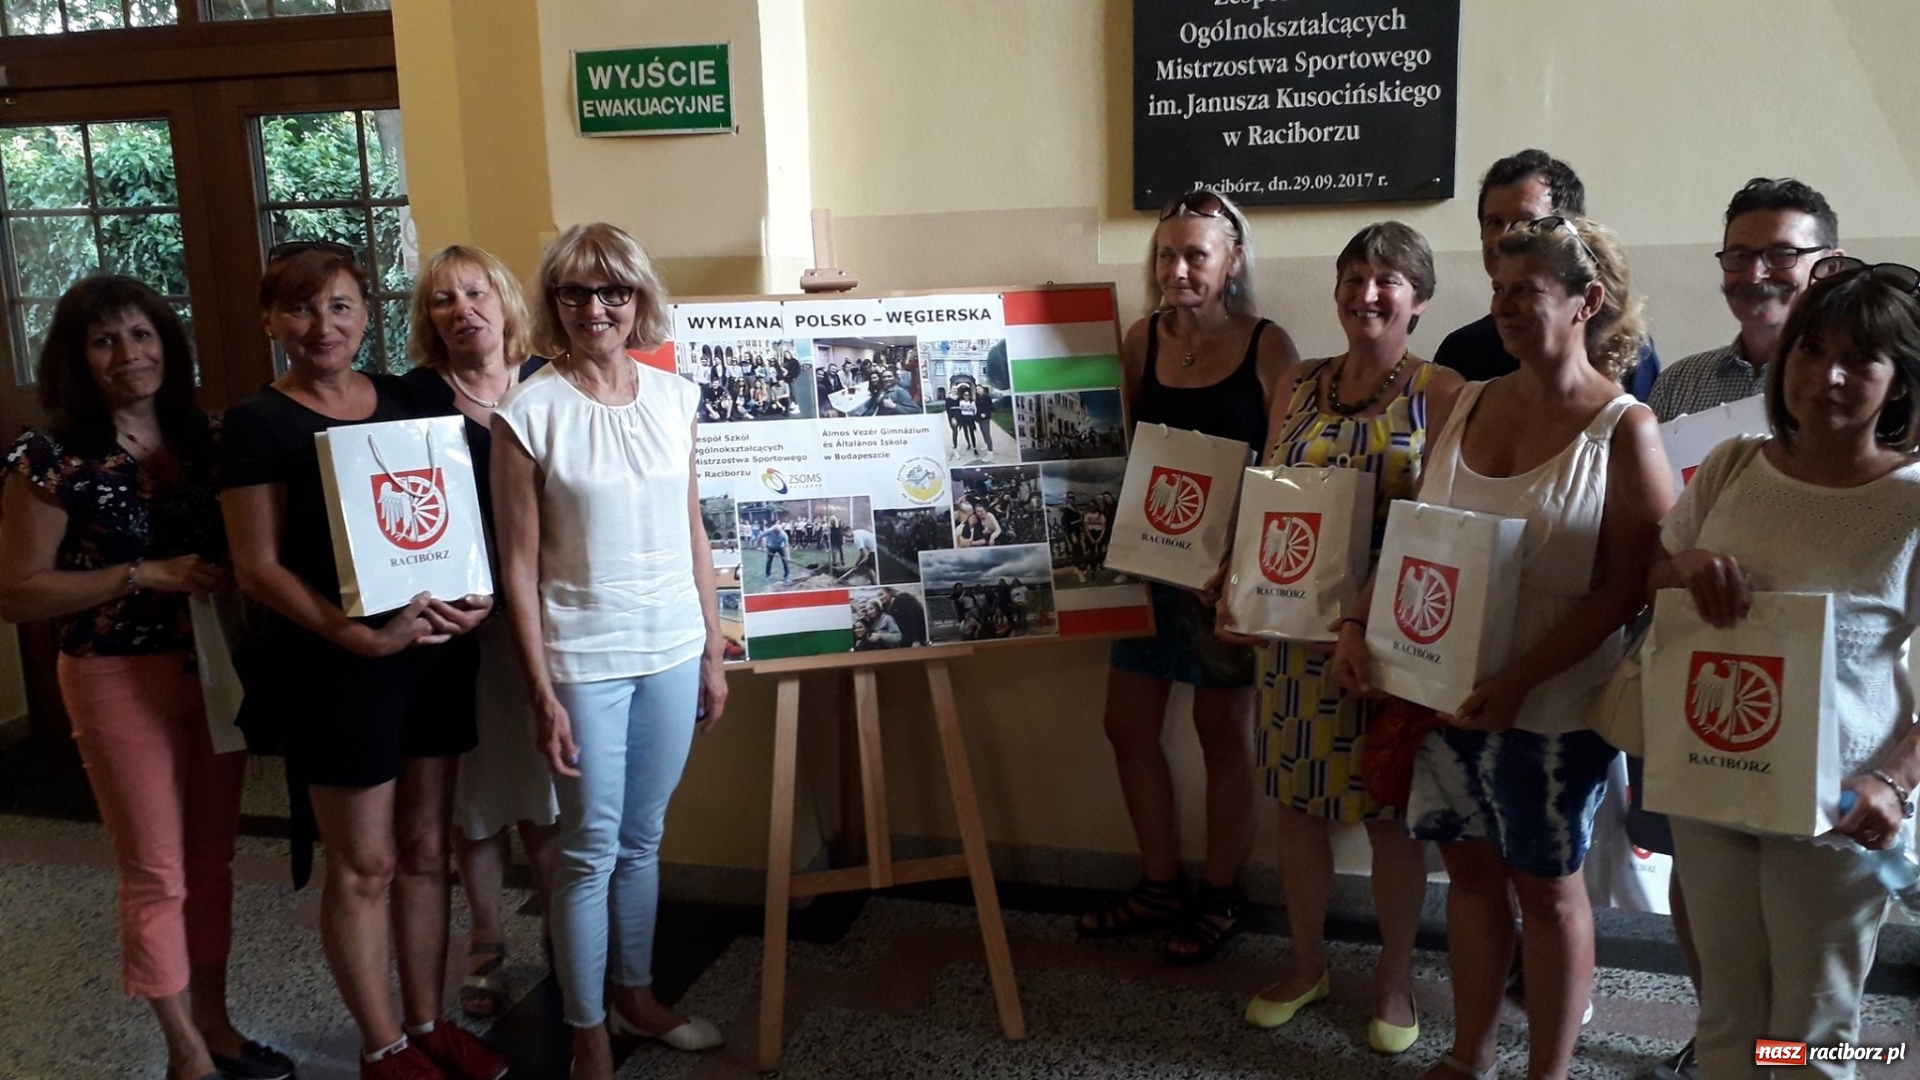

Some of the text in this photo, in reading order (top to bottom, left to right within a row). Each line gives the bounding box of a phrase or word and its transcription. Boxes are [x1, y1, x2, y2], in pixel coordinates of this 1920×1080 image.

[1179, 7, 1407, 49] Ogólnokształcących
[587, 56, 717, 91] WYJŚCIE
[1156, 48, 1432, 81] Mistrzostwa Sportowego
[1276, 80, 1442, 110] Kusocińskiego
[582, 94, 725, 119] EWAKUACYJNE
[1223, 122, 1361, 147] w Raciborzu
[1194, 177, 1264, 194] Racibórz,
[1377, 174, 1389, 187] r.
[687, 315, 781, 330] WYMIANA
[794, 313, 867, 328] POLSKO
[885, 307, 992, 326] WĘGIERSKA
[696, 434, 749, 444] espół Szkół
[852, 428, 877, 436] Vezér
[880, 427, 930, 435] Gimnázium
[823, 440, 833, 448] és
[880, 438, 908, 446] Iskola
[752, 454, 808, 465] Sportowego
[834, 451, 890, 461] Budapeszcie
[704, 469, 751, 478] Raciborzu
[788, 473, 822, 484] ZSOMS
[1142, 532, 1192, 550] RACIBÓRZ
[389, 550, 451, 567] RACIBÓRZ
[1256, 586, 1306, 599] RACIBÓRZ
[1688, 752, 1771, 774] RACIBÓRZ
